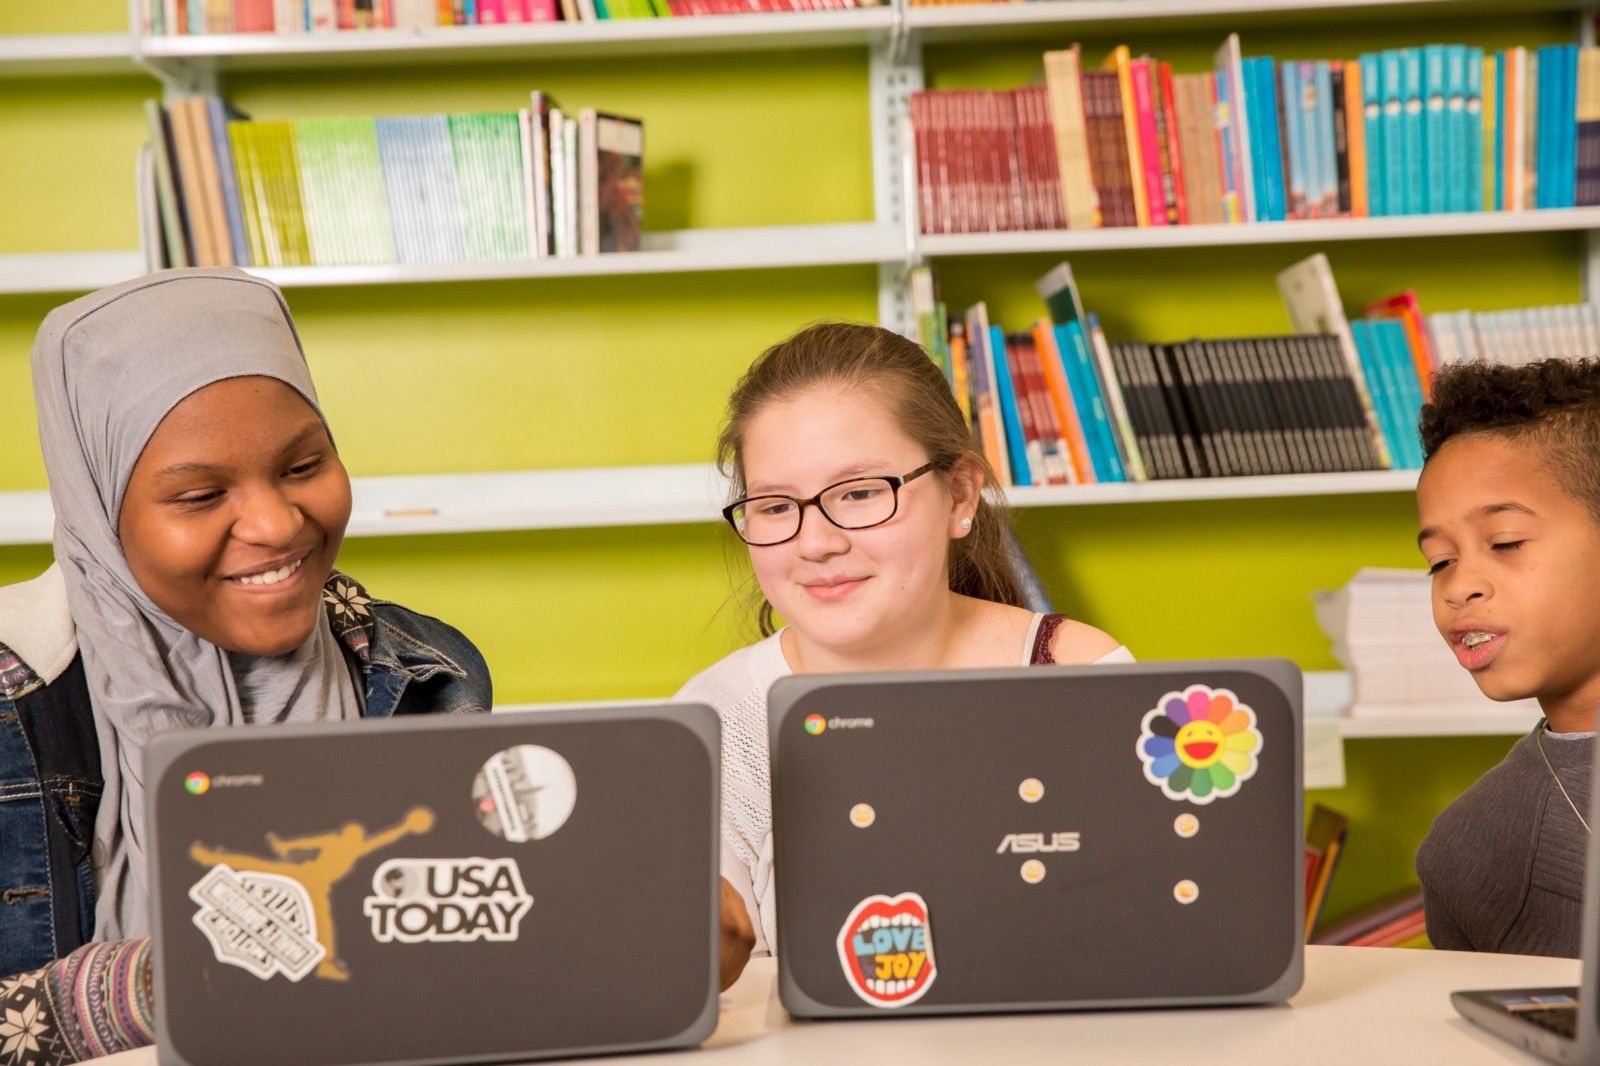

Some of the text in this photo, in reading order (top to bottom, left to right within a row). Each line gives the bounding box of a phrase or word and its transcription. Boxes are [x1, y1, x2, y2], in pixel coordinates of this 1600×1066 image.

[827, 716, 875, 730] chrome
[996, 831, 1081, 854] ASUS
[427, 865, 519, 898] USA
[371, 902, 524, 936] TODAY
[853, 926, 926, 957] LOVE
[874, 951, 928, 981] JOY
